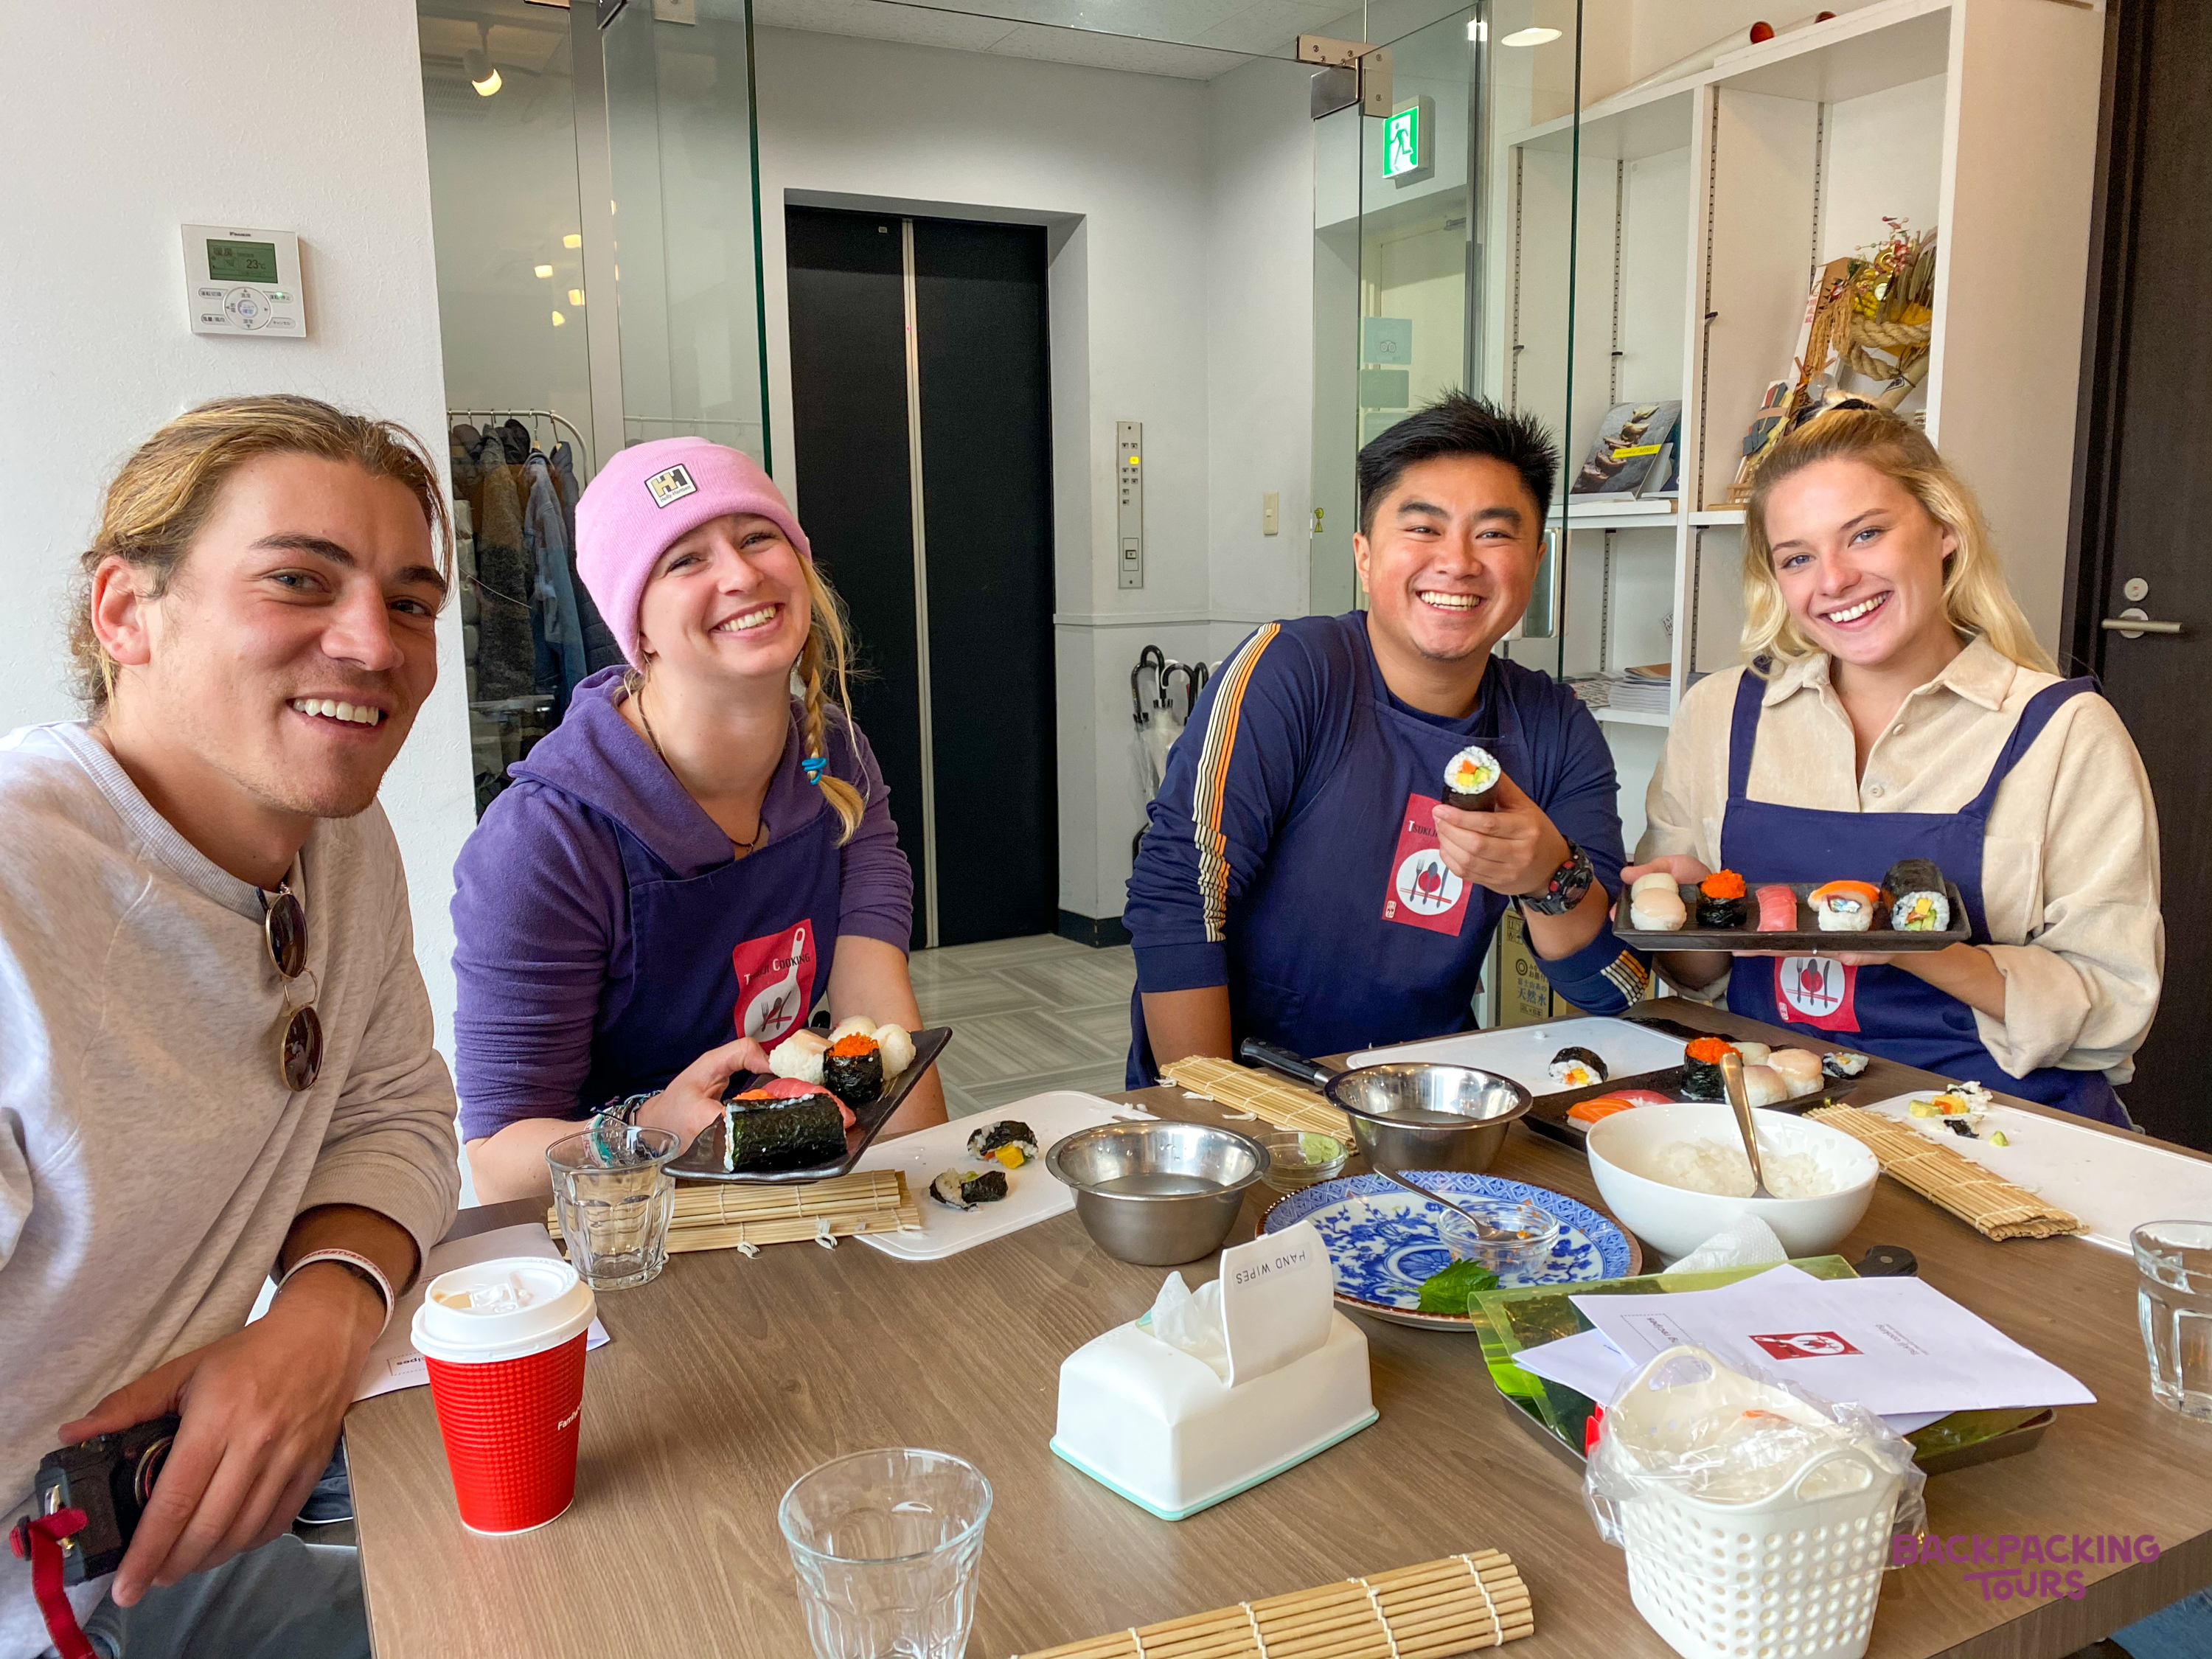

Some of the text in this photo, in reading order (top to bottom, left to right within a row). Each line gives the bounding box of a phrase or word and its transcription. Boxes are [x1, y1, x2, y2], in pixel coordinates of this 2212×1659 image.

[672, 485, 692, 496] Hansen
[772, 953, 810, 972] COOKING
[1517, 988, 1547, 1006] 天然水
[1236, 1249, 1306, 1284] HAND WIPES
